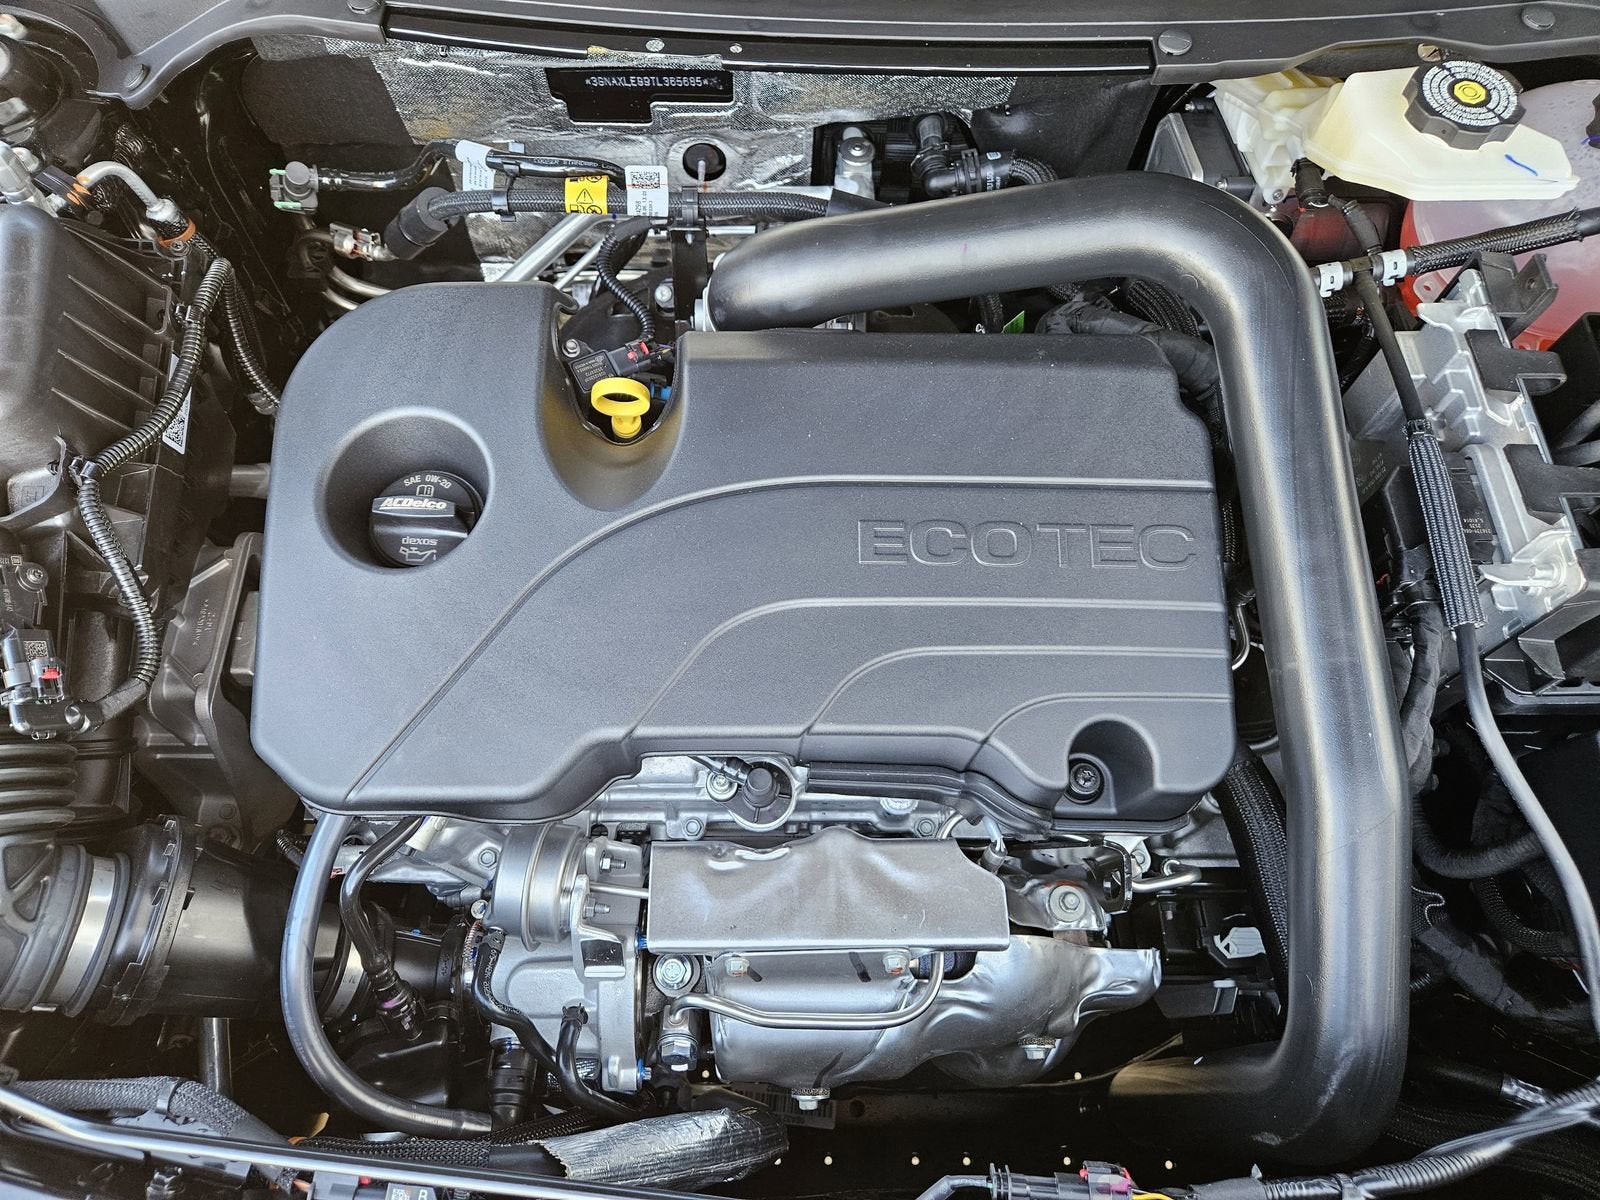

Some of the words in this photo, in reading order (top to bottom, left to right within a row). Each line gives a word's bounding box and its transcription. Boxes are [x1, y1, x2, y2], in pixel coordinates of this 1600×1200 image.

[403, 474, 422, 487] SAE
[425, 474, 452, 489] 0W-20
[379, 498, 448, 510] ACDelco
[401, 536, 438, 546] dexos
[857, 518, 1197, 571] ECOTEC
